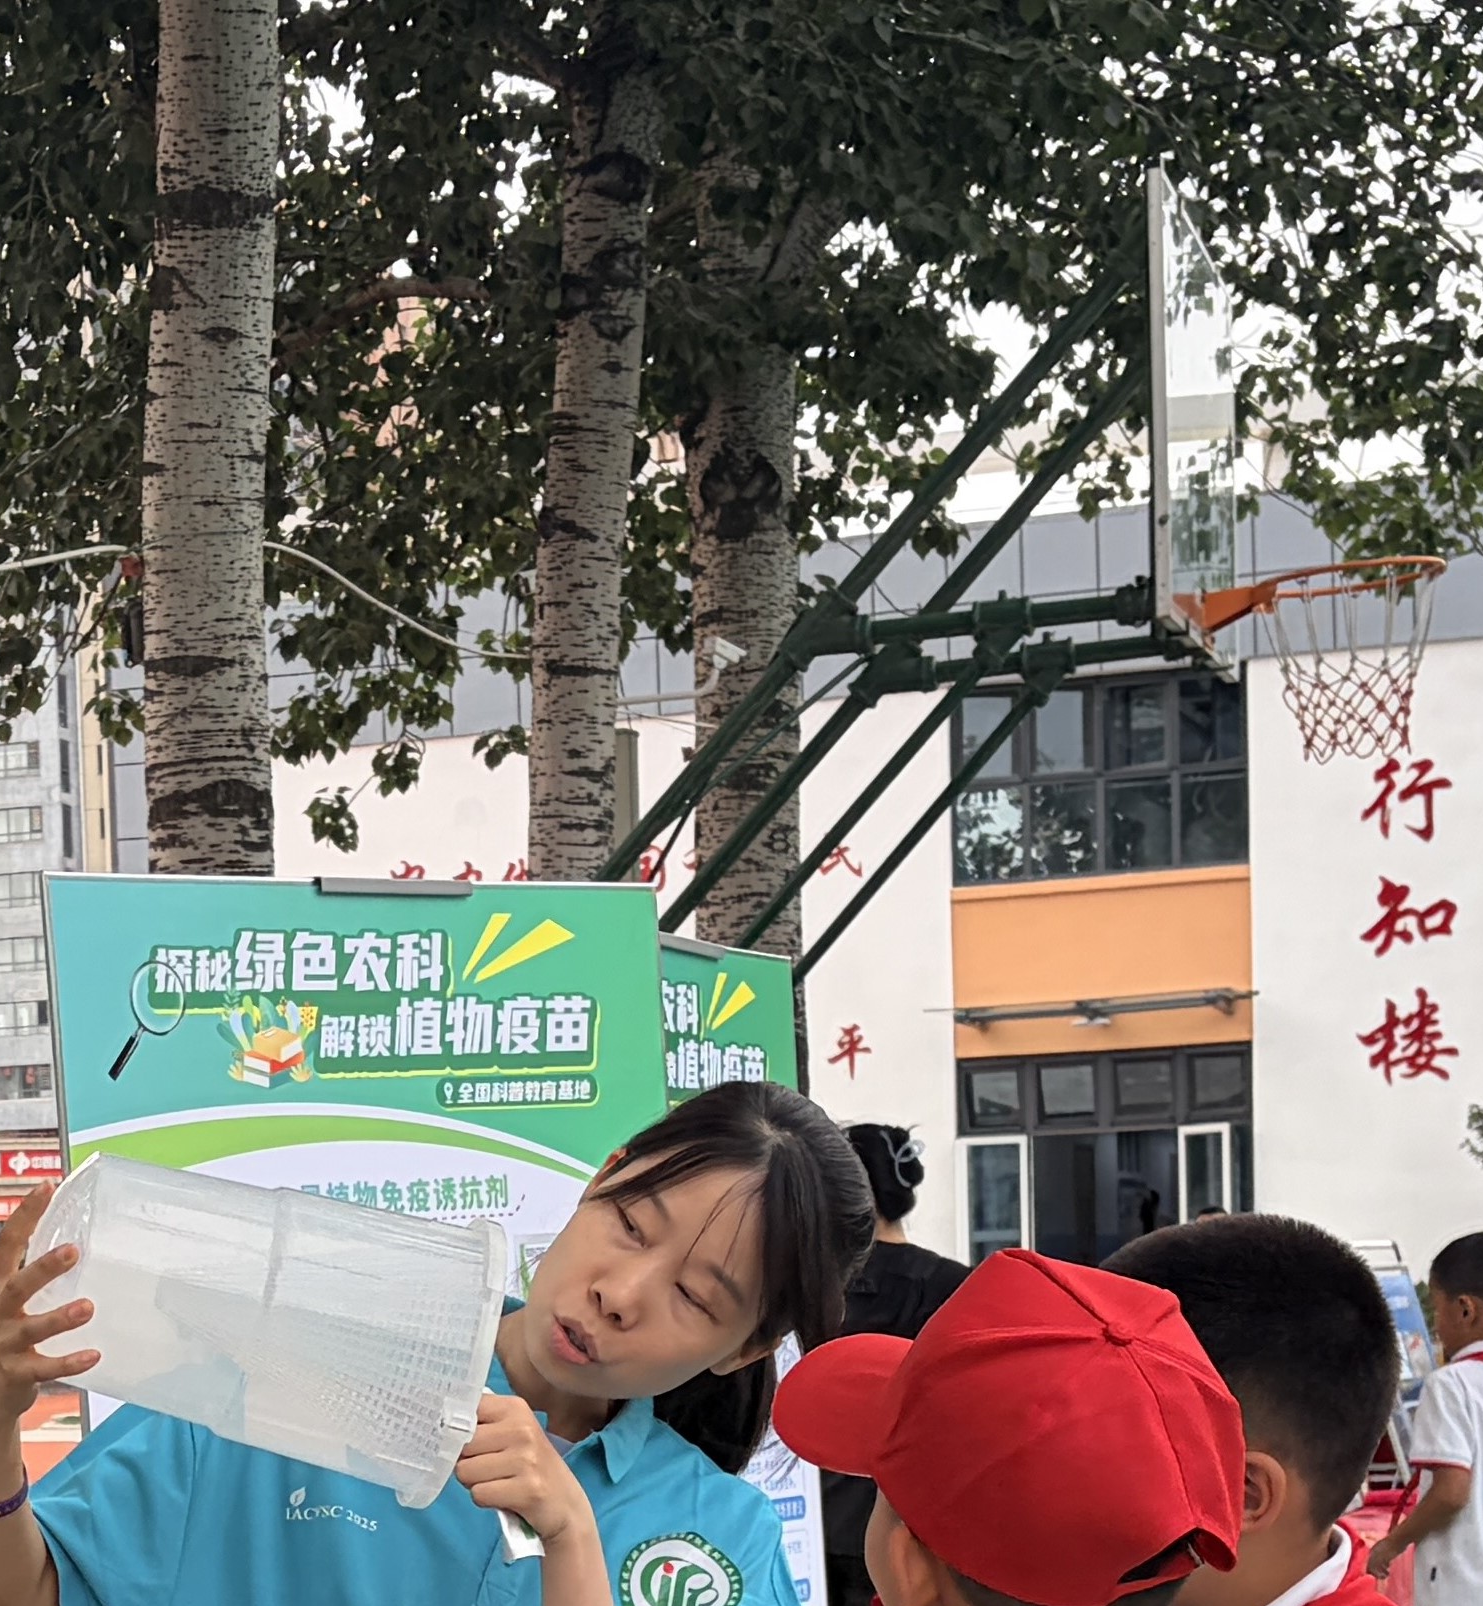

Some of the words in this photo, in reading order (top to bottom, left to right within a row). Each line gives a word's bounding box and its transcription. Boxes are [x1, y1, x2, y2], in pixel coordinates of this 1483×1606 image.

[1357, 758, 1459, 1086] 行知楼
[154, 930, 446, 995] 探秘绿色农科
[319, 995, 592, 1059] 解锁植物疫苗
[828, 1024, 872, 1080] 平
[457, 1081, 592, 1104] 全国科普教育基地
[301, 1174, 510, 1213] 植物免疫诱抗剂
[346, 1508, 379, 1532] 2025
